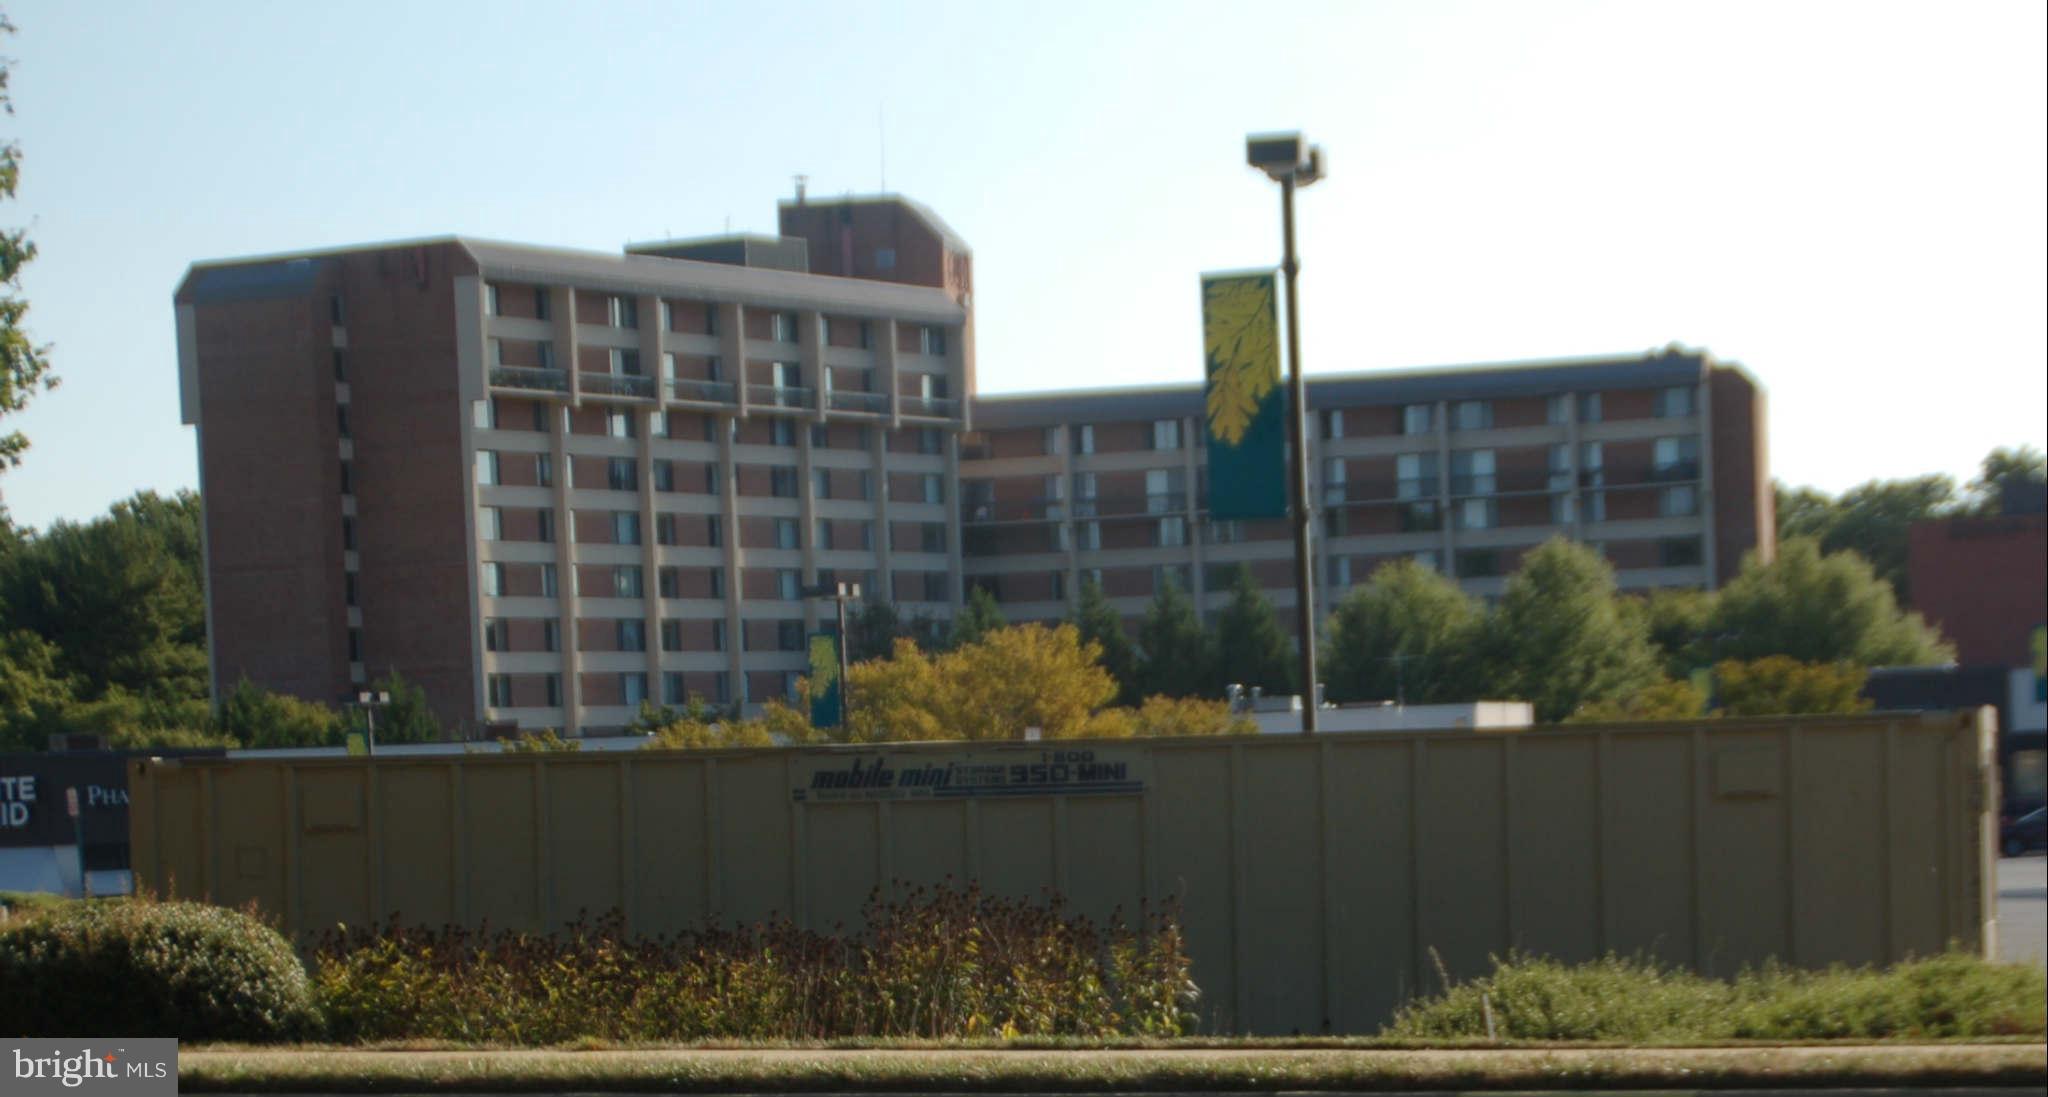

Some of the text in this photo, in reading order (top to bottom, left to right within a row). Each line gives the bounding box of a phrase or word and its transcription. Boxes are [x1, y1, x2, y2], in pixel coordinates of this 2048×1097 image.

[811, 757, 954, 789] mobile mini
[1009, 763, 1127, 782] 950-MINI
